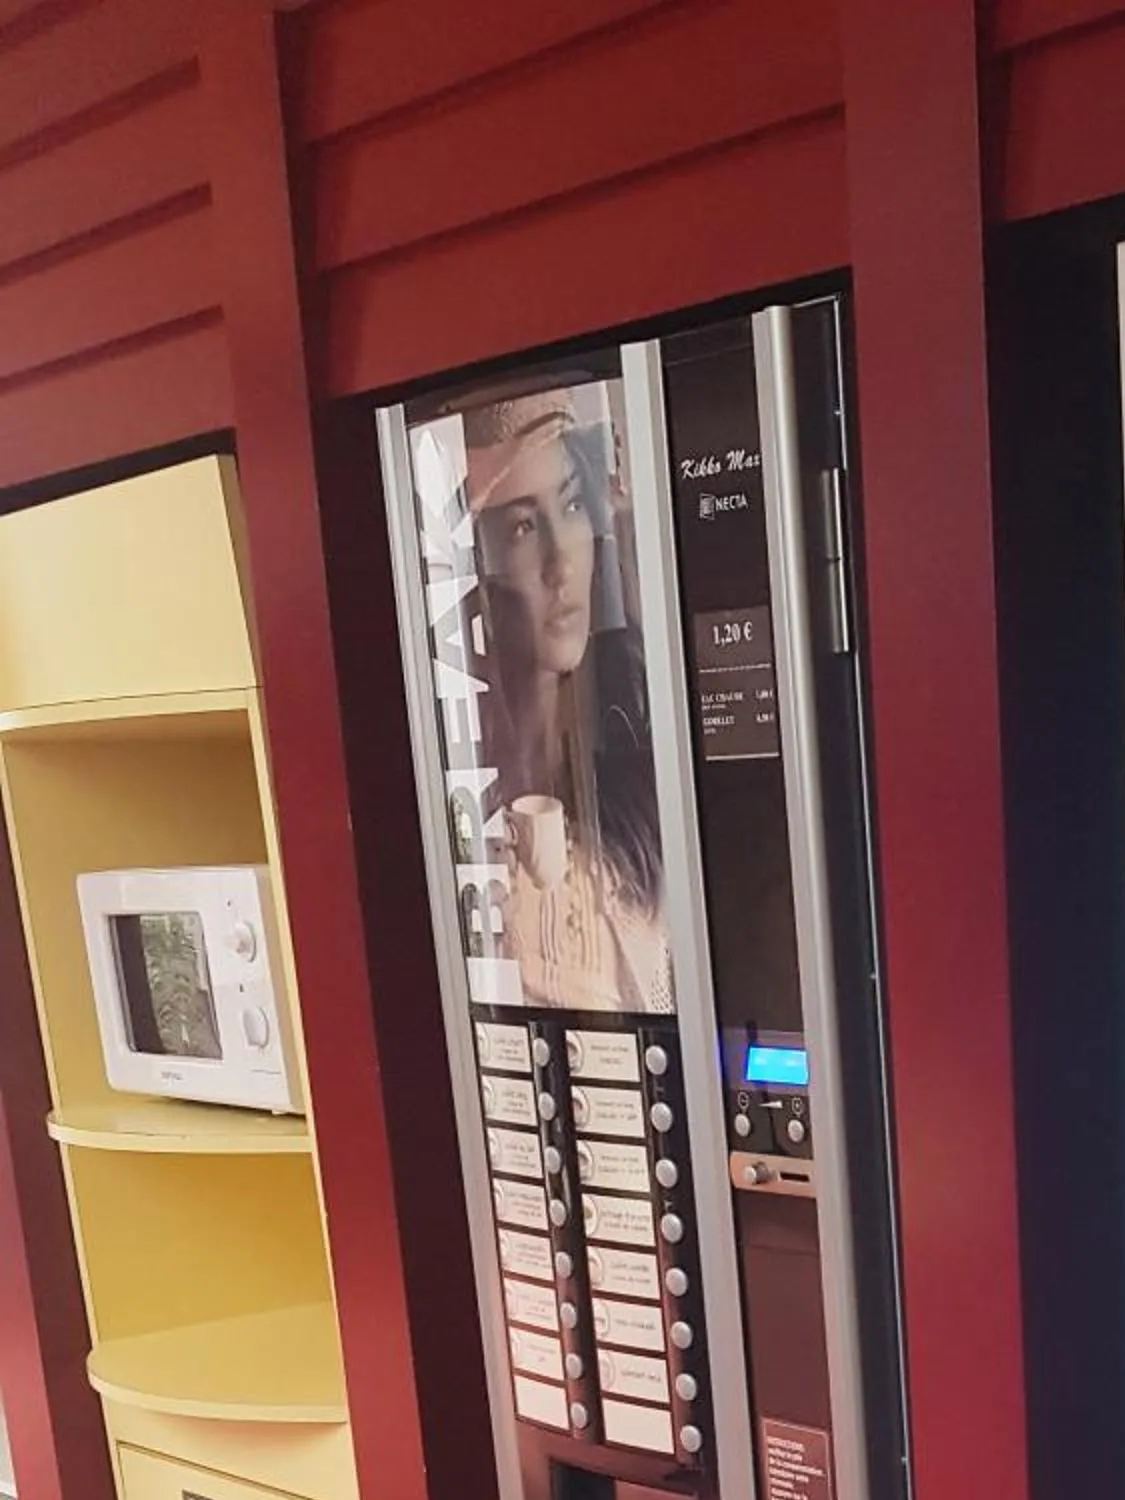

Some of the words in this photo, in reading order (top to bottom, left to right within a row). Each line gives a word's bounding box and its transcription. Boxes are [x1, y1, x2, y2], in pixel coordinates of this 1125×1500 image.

[681, 456, 721, 480] Kikko
[715, 493, 749, 512] NECTA
[743, 621, 753, 641] €
